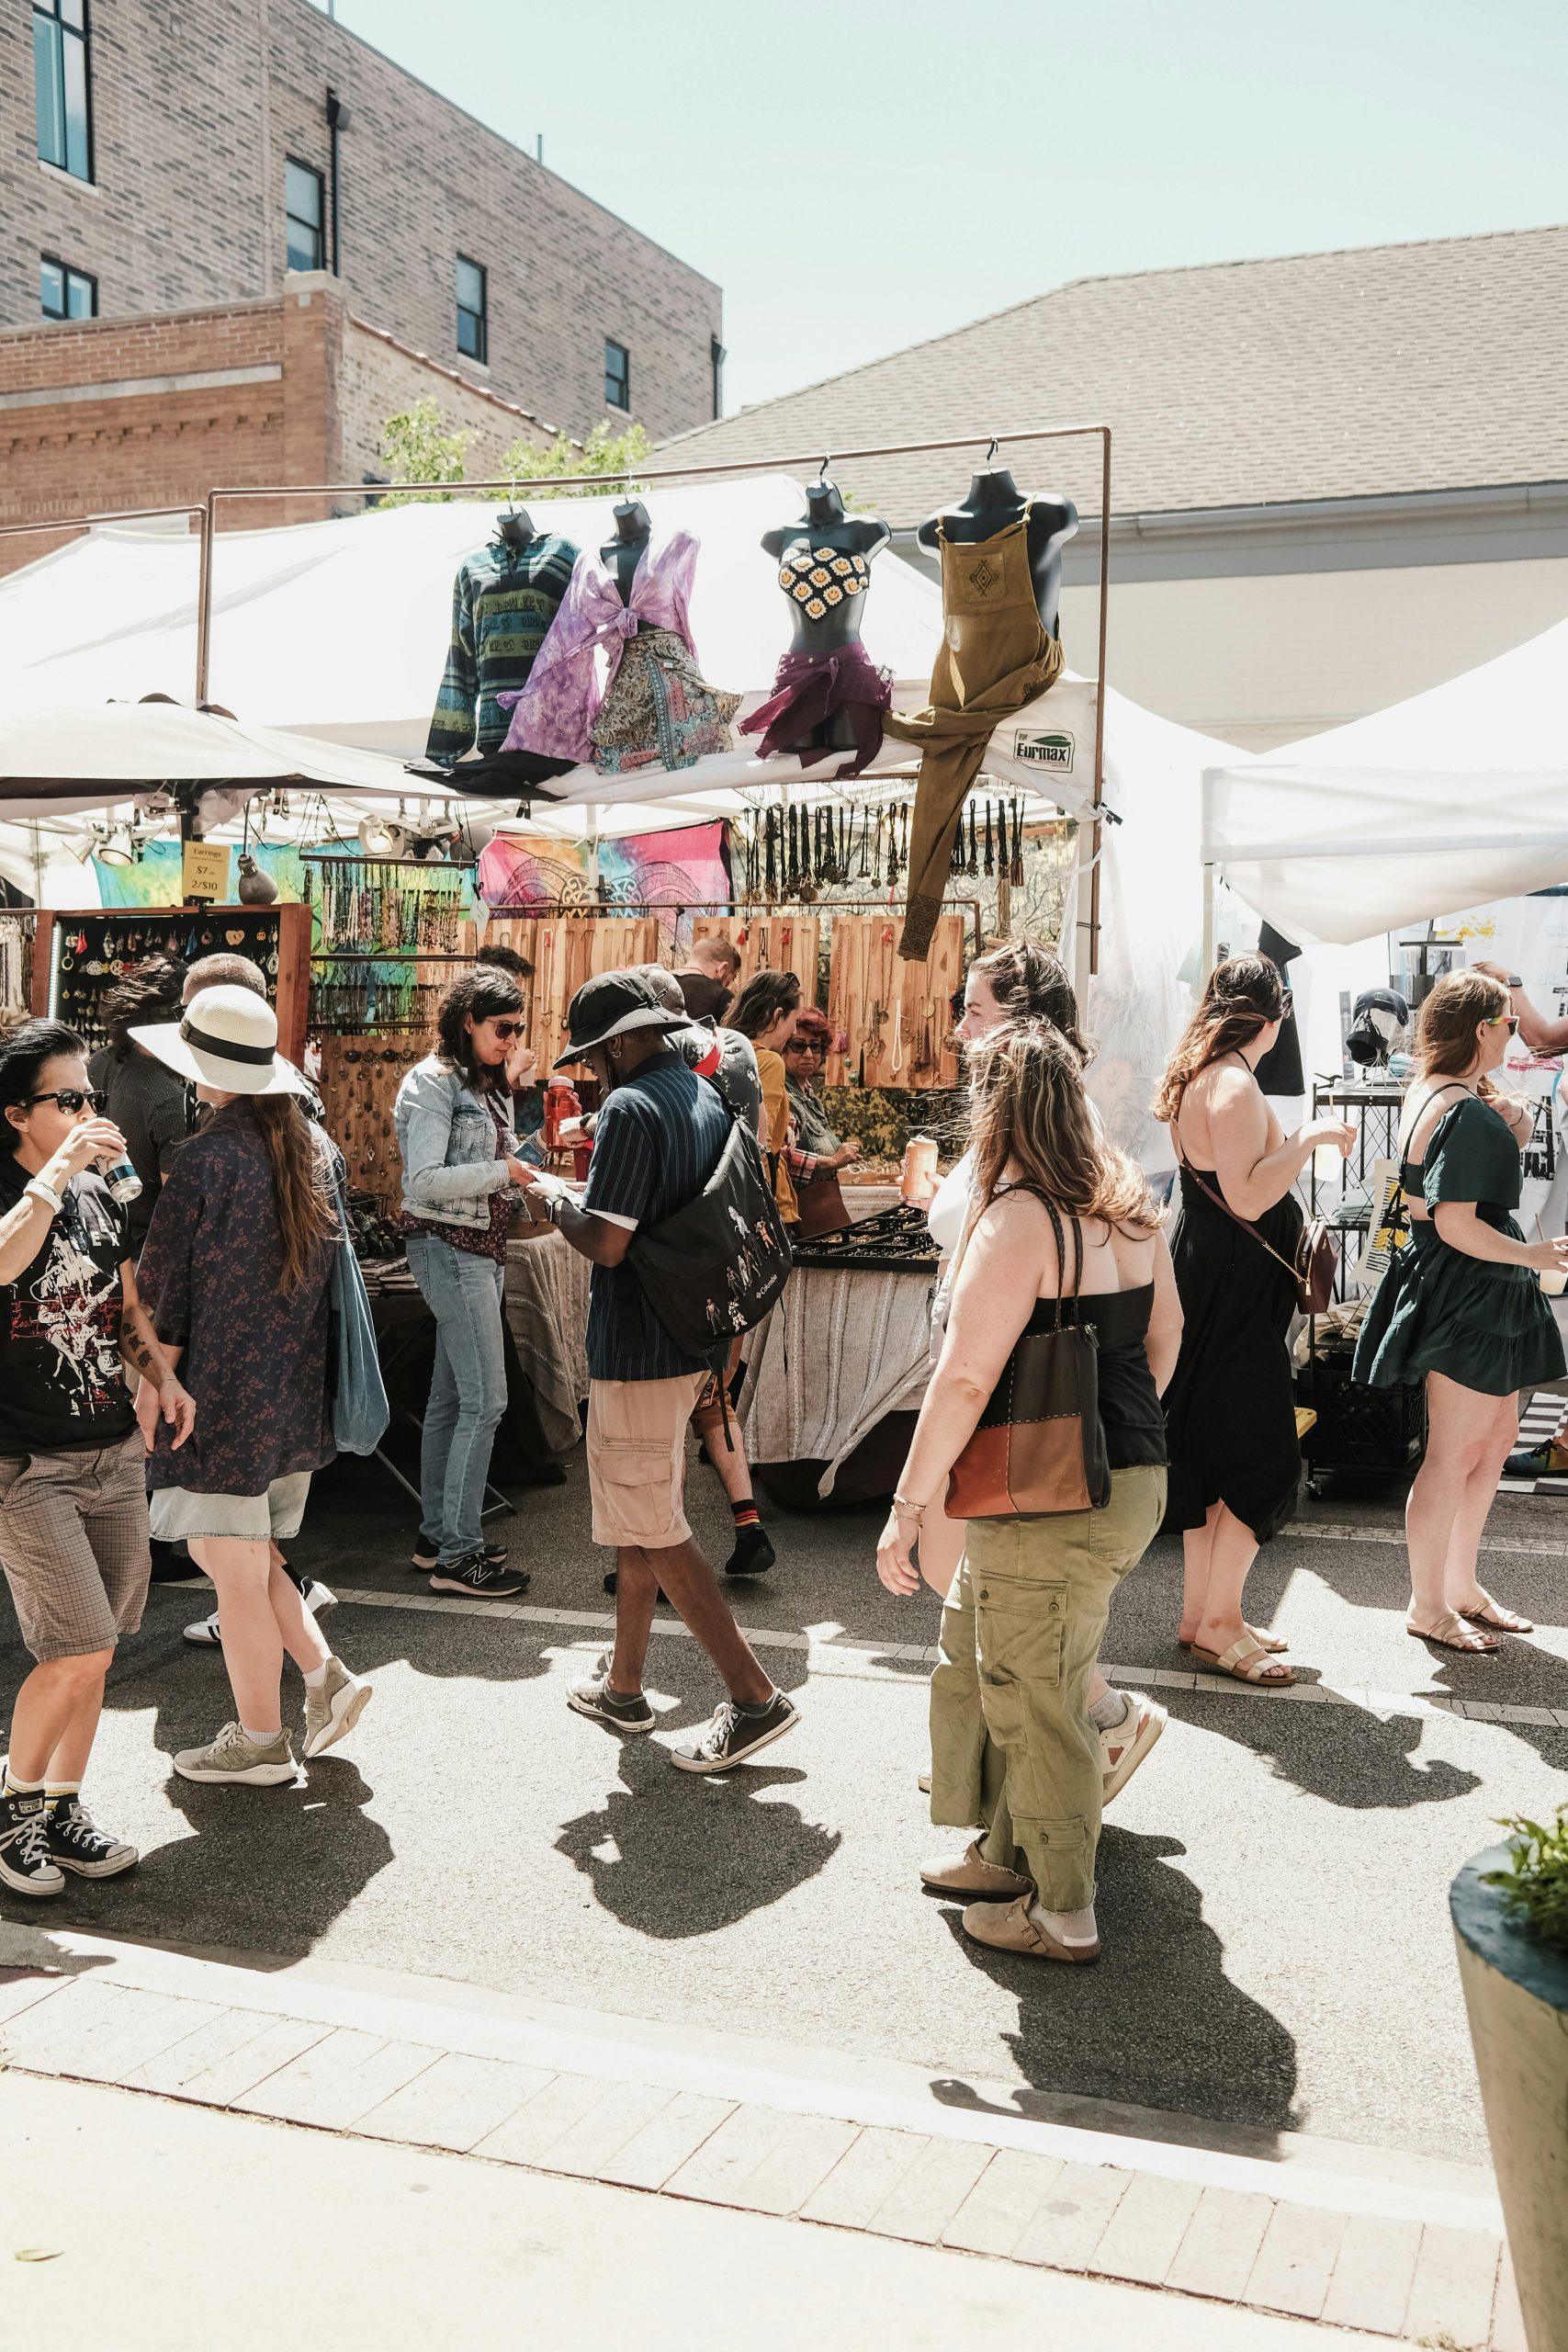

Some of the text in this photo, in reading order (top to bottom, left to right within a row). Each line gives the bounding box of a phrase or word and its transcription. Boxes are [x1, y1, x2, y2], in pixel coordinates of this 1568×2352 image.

[1017, 743, 1066, 762] Eurmax
[194, 848, 221, 858] Earrings
[197, 865, 208, 875] $7
[192, 880, 218, 891] 2/$10
